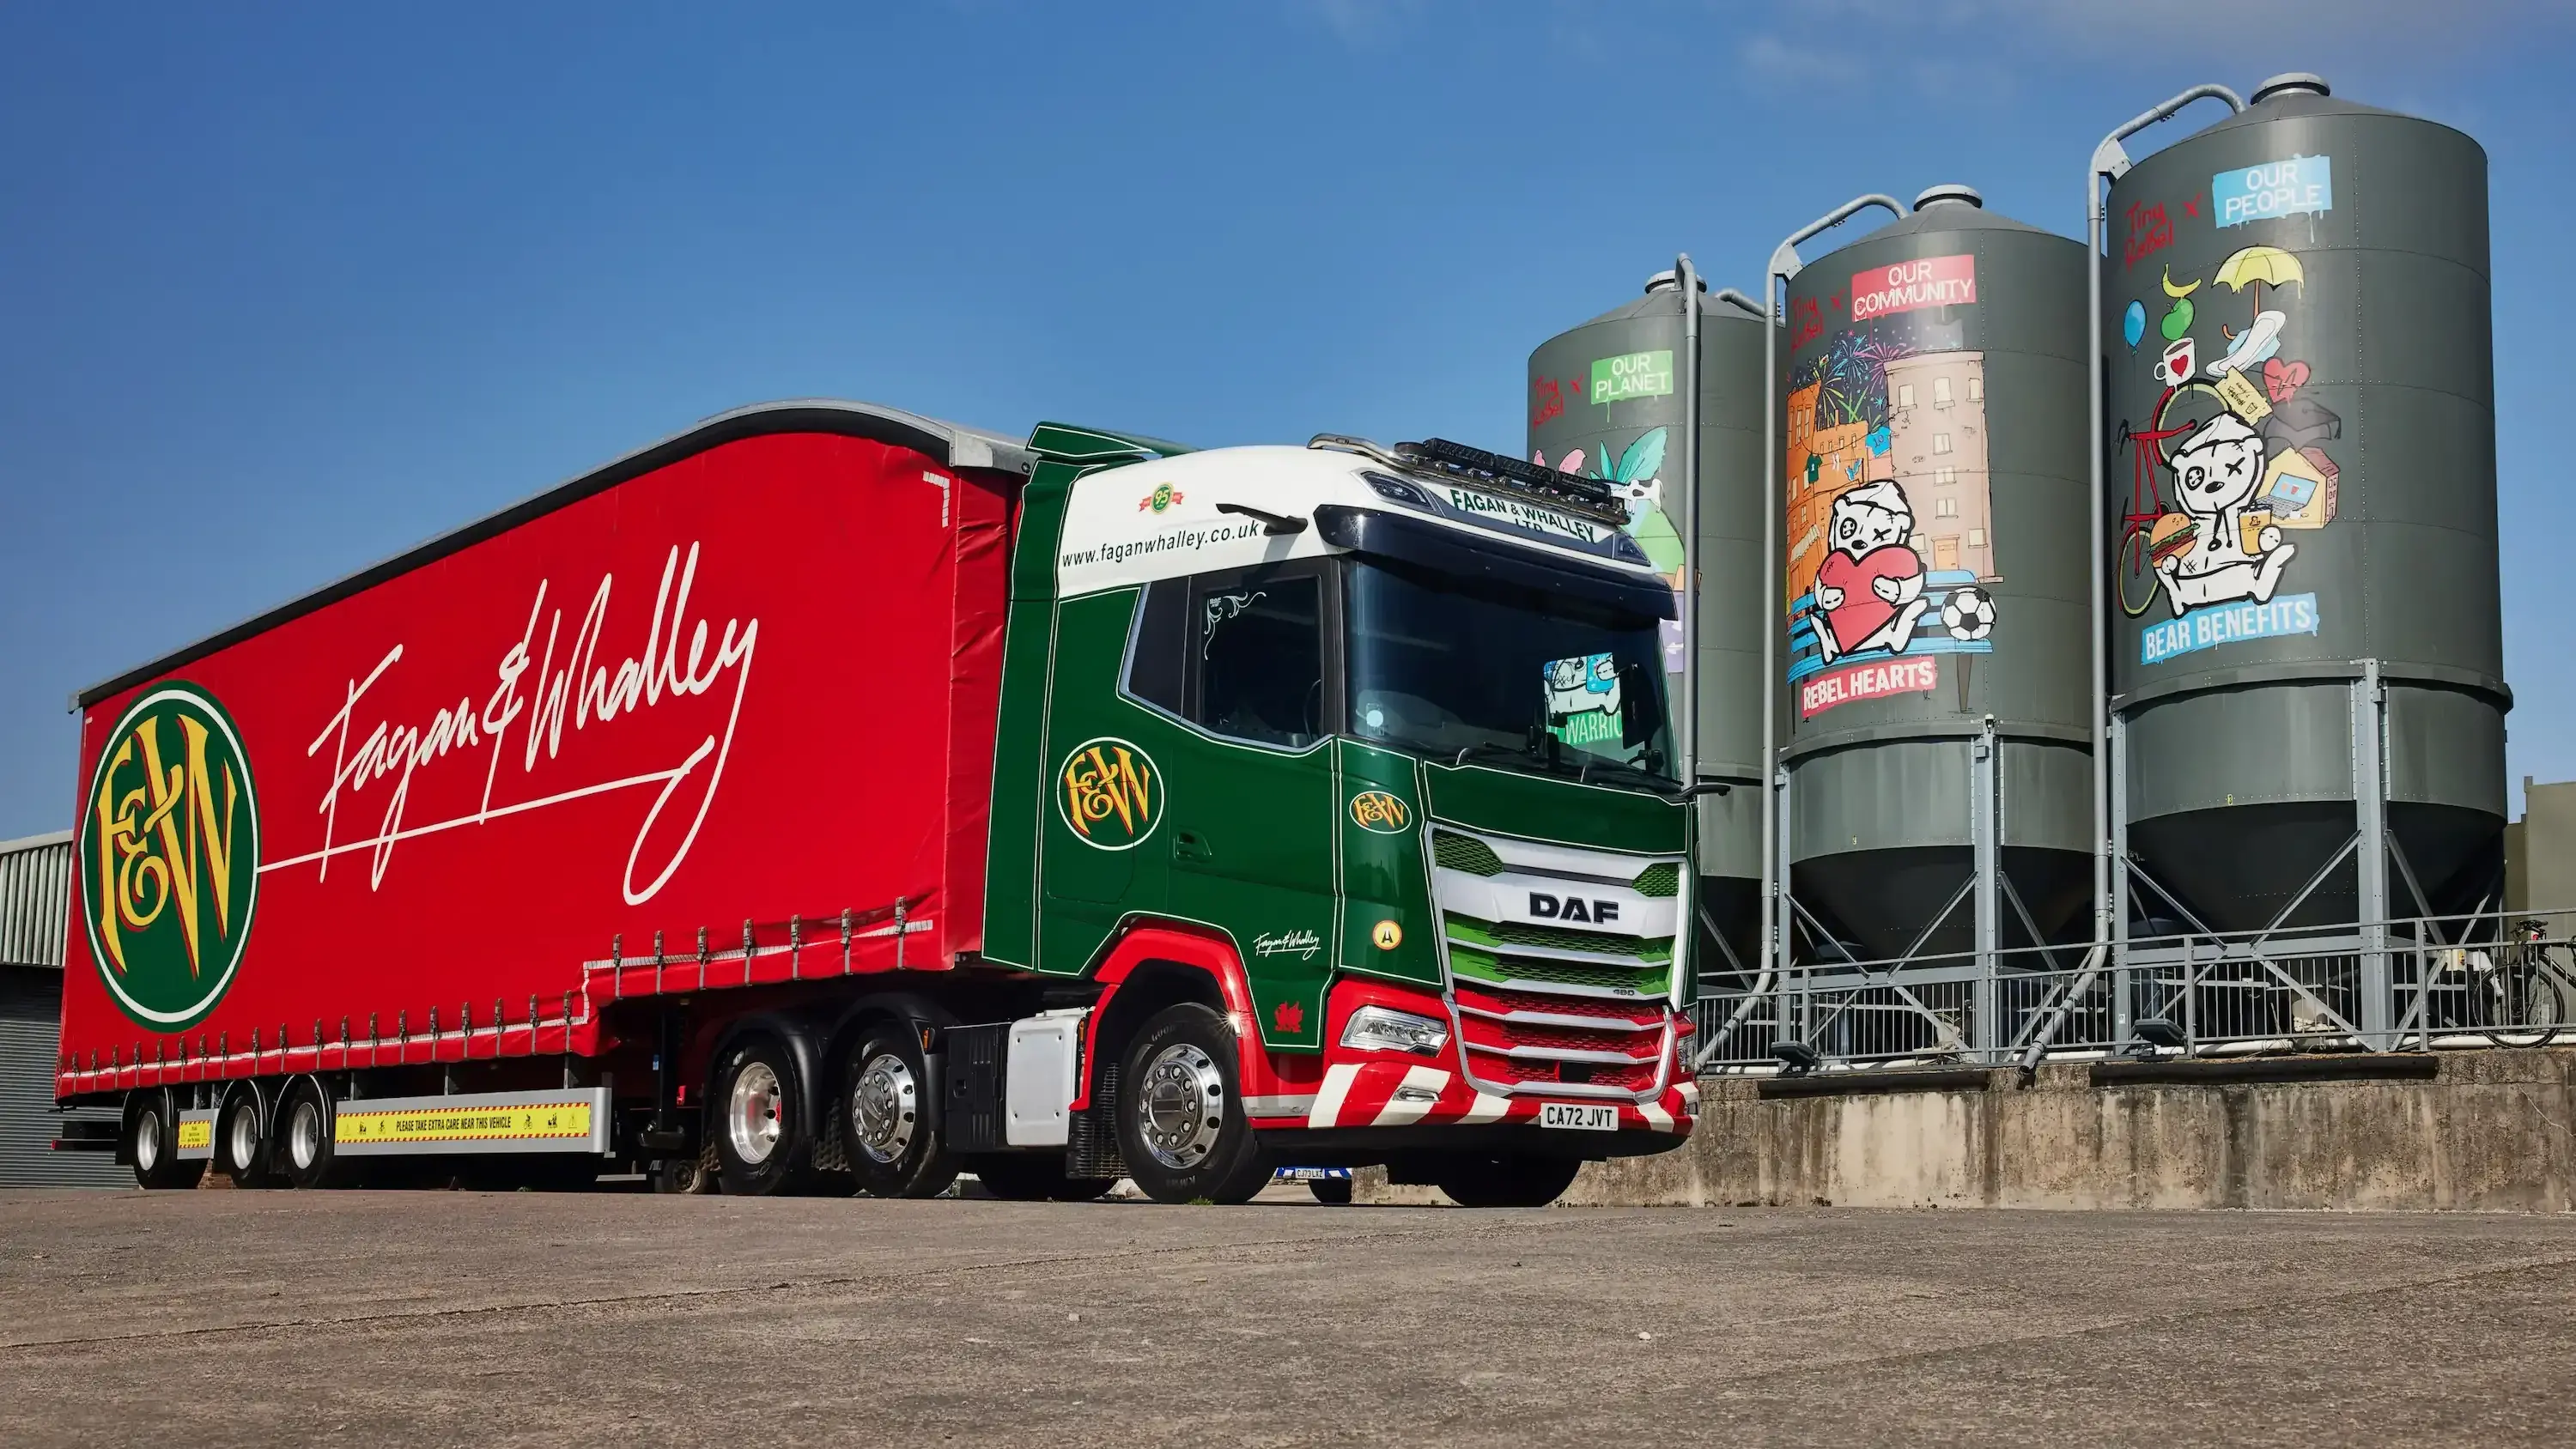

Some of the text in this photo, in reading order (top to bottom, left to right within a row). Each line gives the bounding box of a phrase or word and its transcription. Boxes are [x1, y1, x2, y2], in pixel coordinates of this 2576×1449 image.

[2245, 162, 2299, 191] OUR
[2124, 199, 2167, 232] Tiny
[2225, 185, 2324, 221] PEOPLE
[2123, 219, 2175, 275] Rebel
[1887, 261, 1933, 287] OUR
[1854, 278, 1973, 317] COMMUNITY
[1611, 354, 1651, 377] OUR
[1595, 371, 1670, 399] PLANET
[1155, 489, 1170, 505] 95
[1449, 488, 1597, 545] FAGAN & WHALLEY
[1061, 520, 1260, 568] www.faganwhalley.co.uk
[2146, 599, 2312, 660] BEAR BENEFITS
[1803, 661, 1934, 711] REBEL HEARTS
[308, 644, 479, 893] Fagan
[525, 540, 759, 907] Whalley
[1565, 710, 1624, 744] WARRIO
[1529, 891, 1619, 925] DAF
[396, 1116, 512, 1132] PLEASE TAKE EXTRA CARE NEAR THIS VEHICLE
[1546, 1106, 1613, 1127] CA72 JVT
